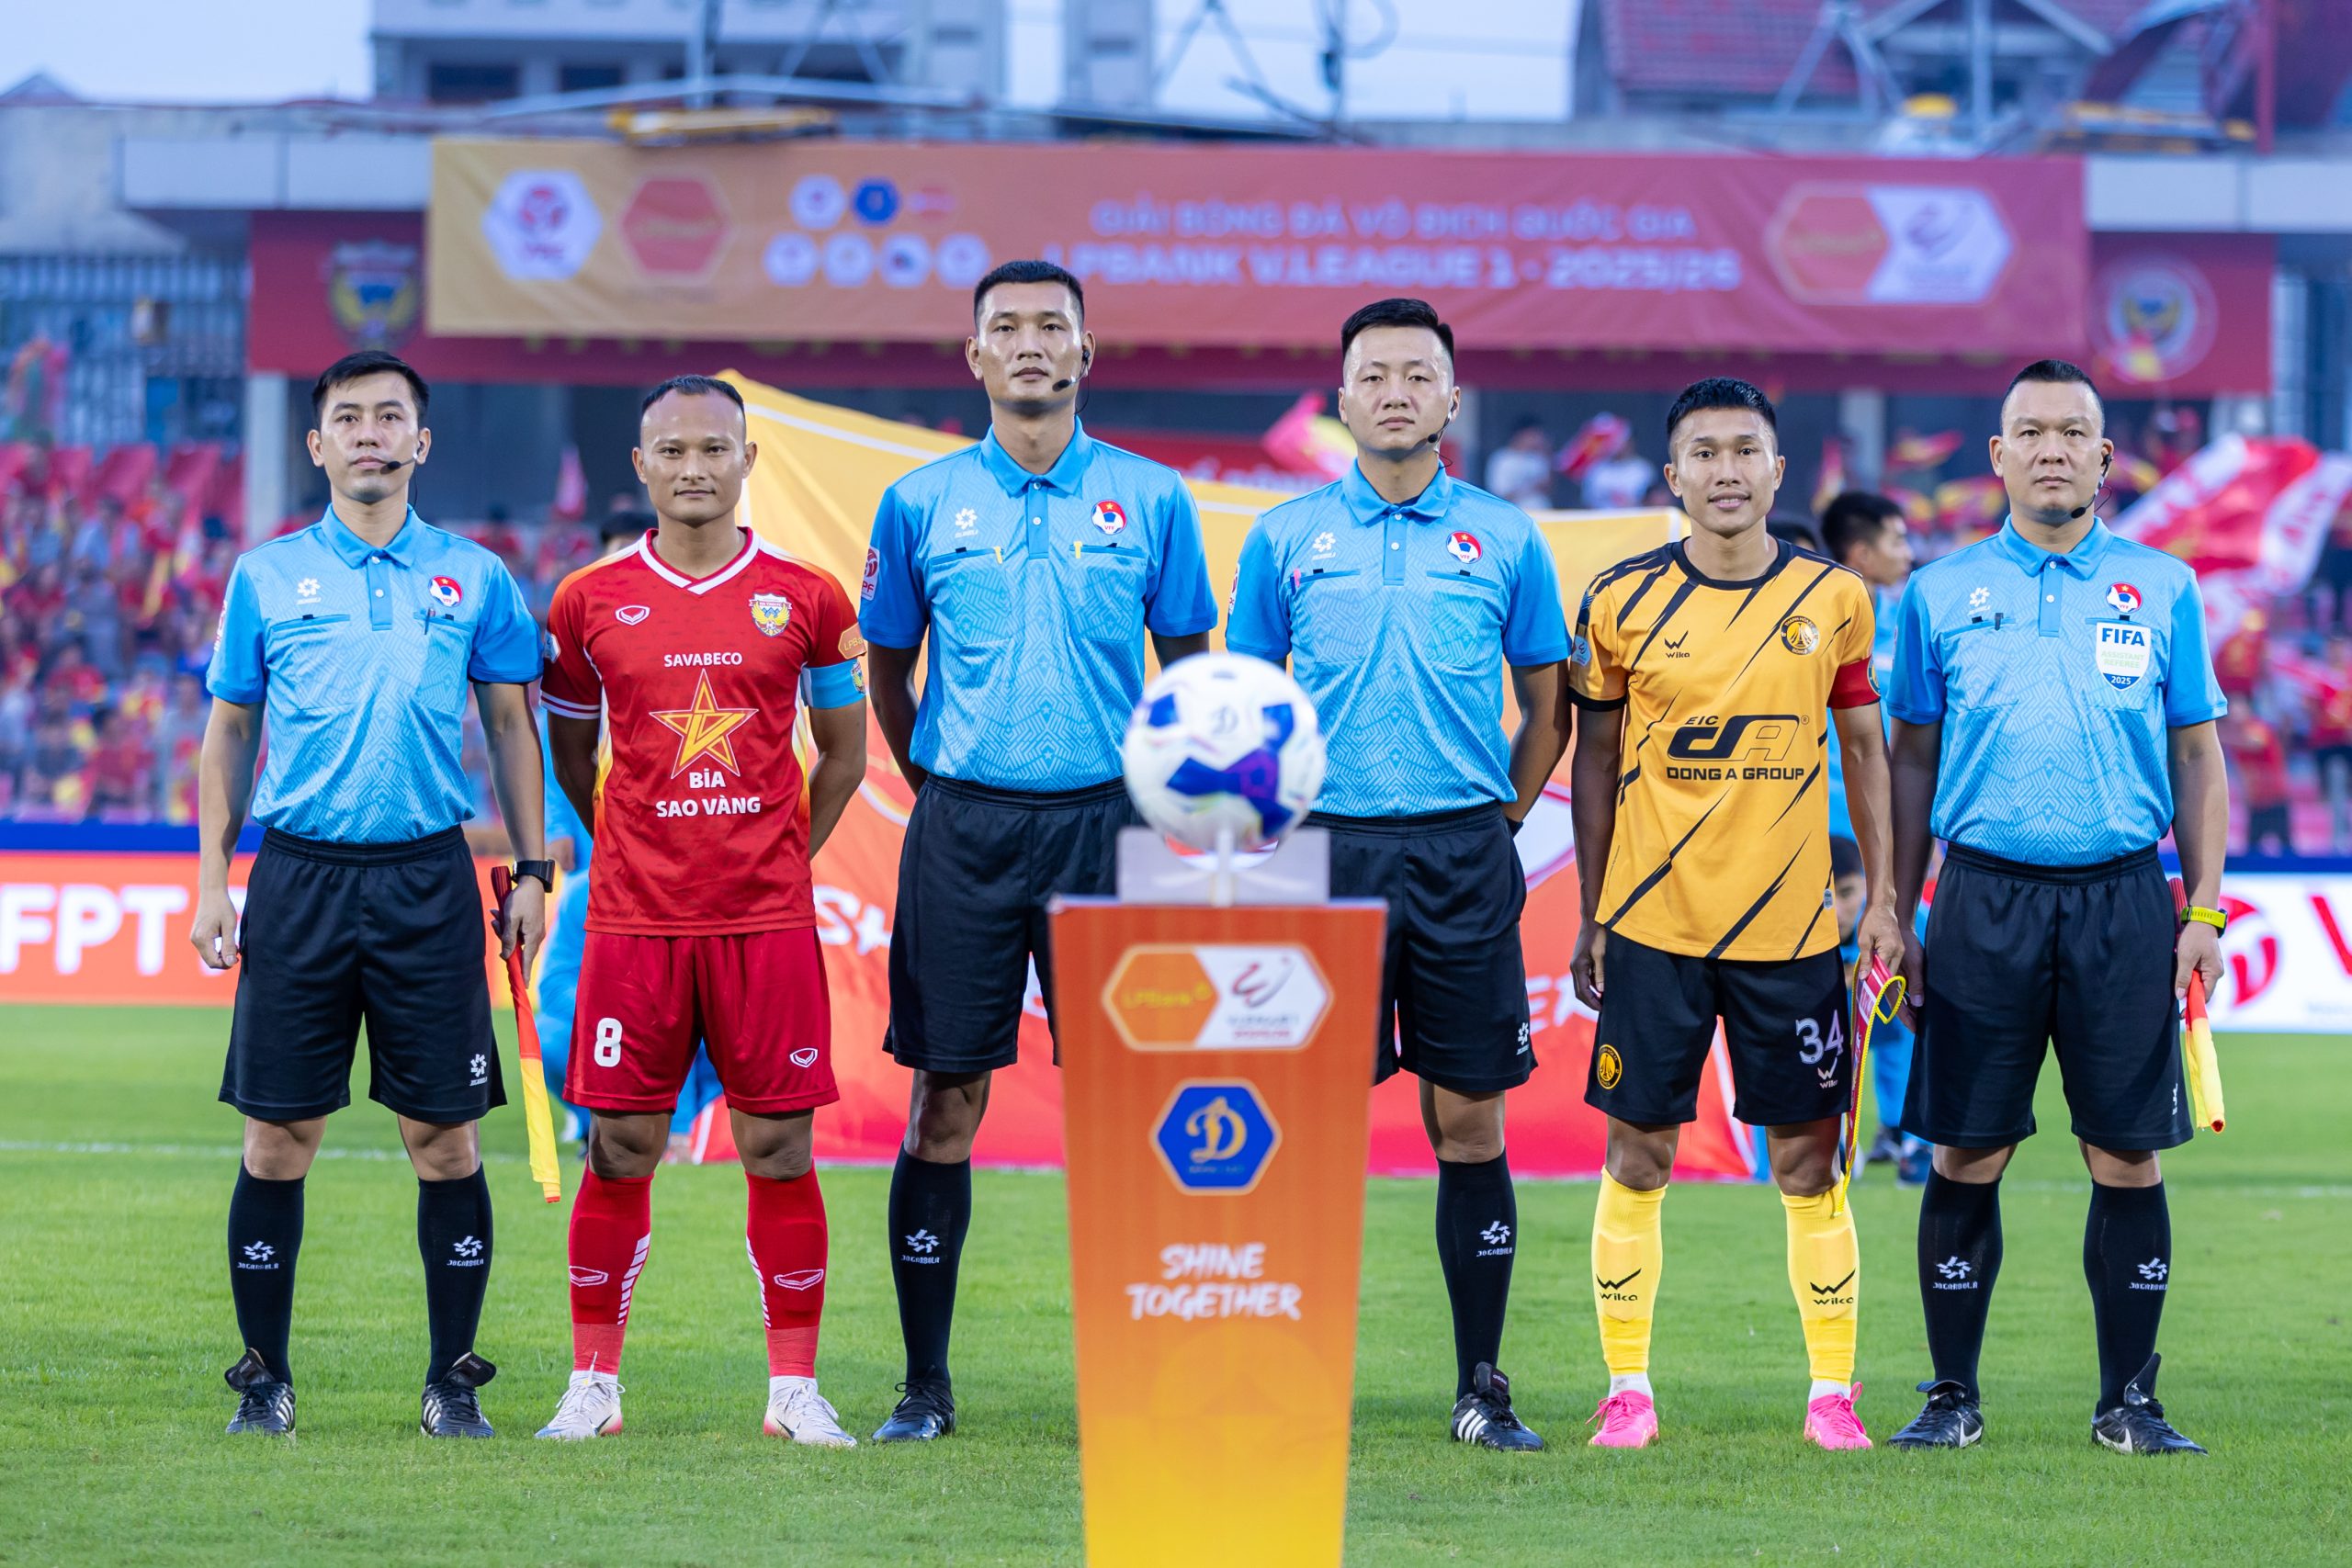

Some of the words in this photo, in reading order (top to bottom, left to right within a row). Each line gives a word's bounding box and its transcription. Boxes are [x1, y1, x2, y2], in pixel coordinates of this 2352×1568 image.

[2102, 628, 2145, 647] FIFA
[663, 652, 743, 668] SAVABECO
[2101, 650, 2144, 661] ASSISTANT
[2104, 659, 2140, 669] REFEREE
[2111, 676, 2132, 685] 2025
[1685, 716, 1719, 725] EIC
[1667, 767, 1722, 780] DONG
[1724, 768, 1737, 780] A
[1743, 768, 1804, 780] GROUP
[657, 800, 698, 818] SAO
[702, 796, 762, 816] VÀNG
[0, 883, 188, 976] FPT
[594, 1017, 623, 1067] 8
[1795, 1009, 1845, 1065] 34
[1159, 1242, 1266, 1280] SHINE
[1125, 1283, 1303, 1321] TOGETHER
